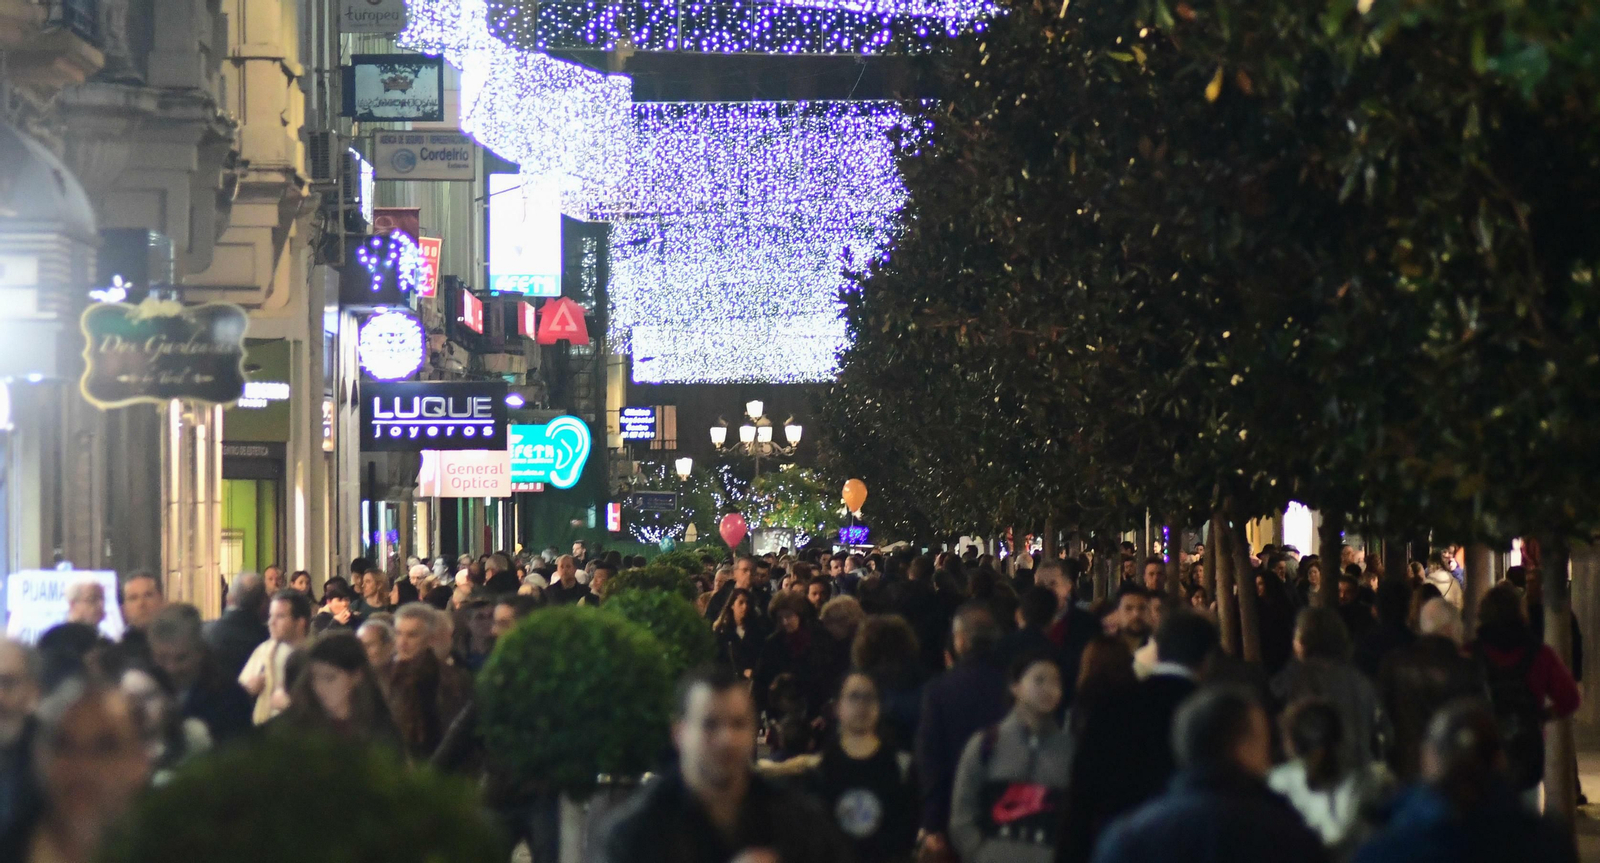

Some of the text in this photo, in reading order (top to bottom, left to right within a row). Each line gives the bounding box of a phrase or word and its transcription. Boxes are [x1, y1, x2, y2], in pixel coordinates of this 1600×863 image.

[373, 396, 493, 419] LUQUE
[373, 423, 494, 439] joyeros
[446, 462, 504, 475] General
